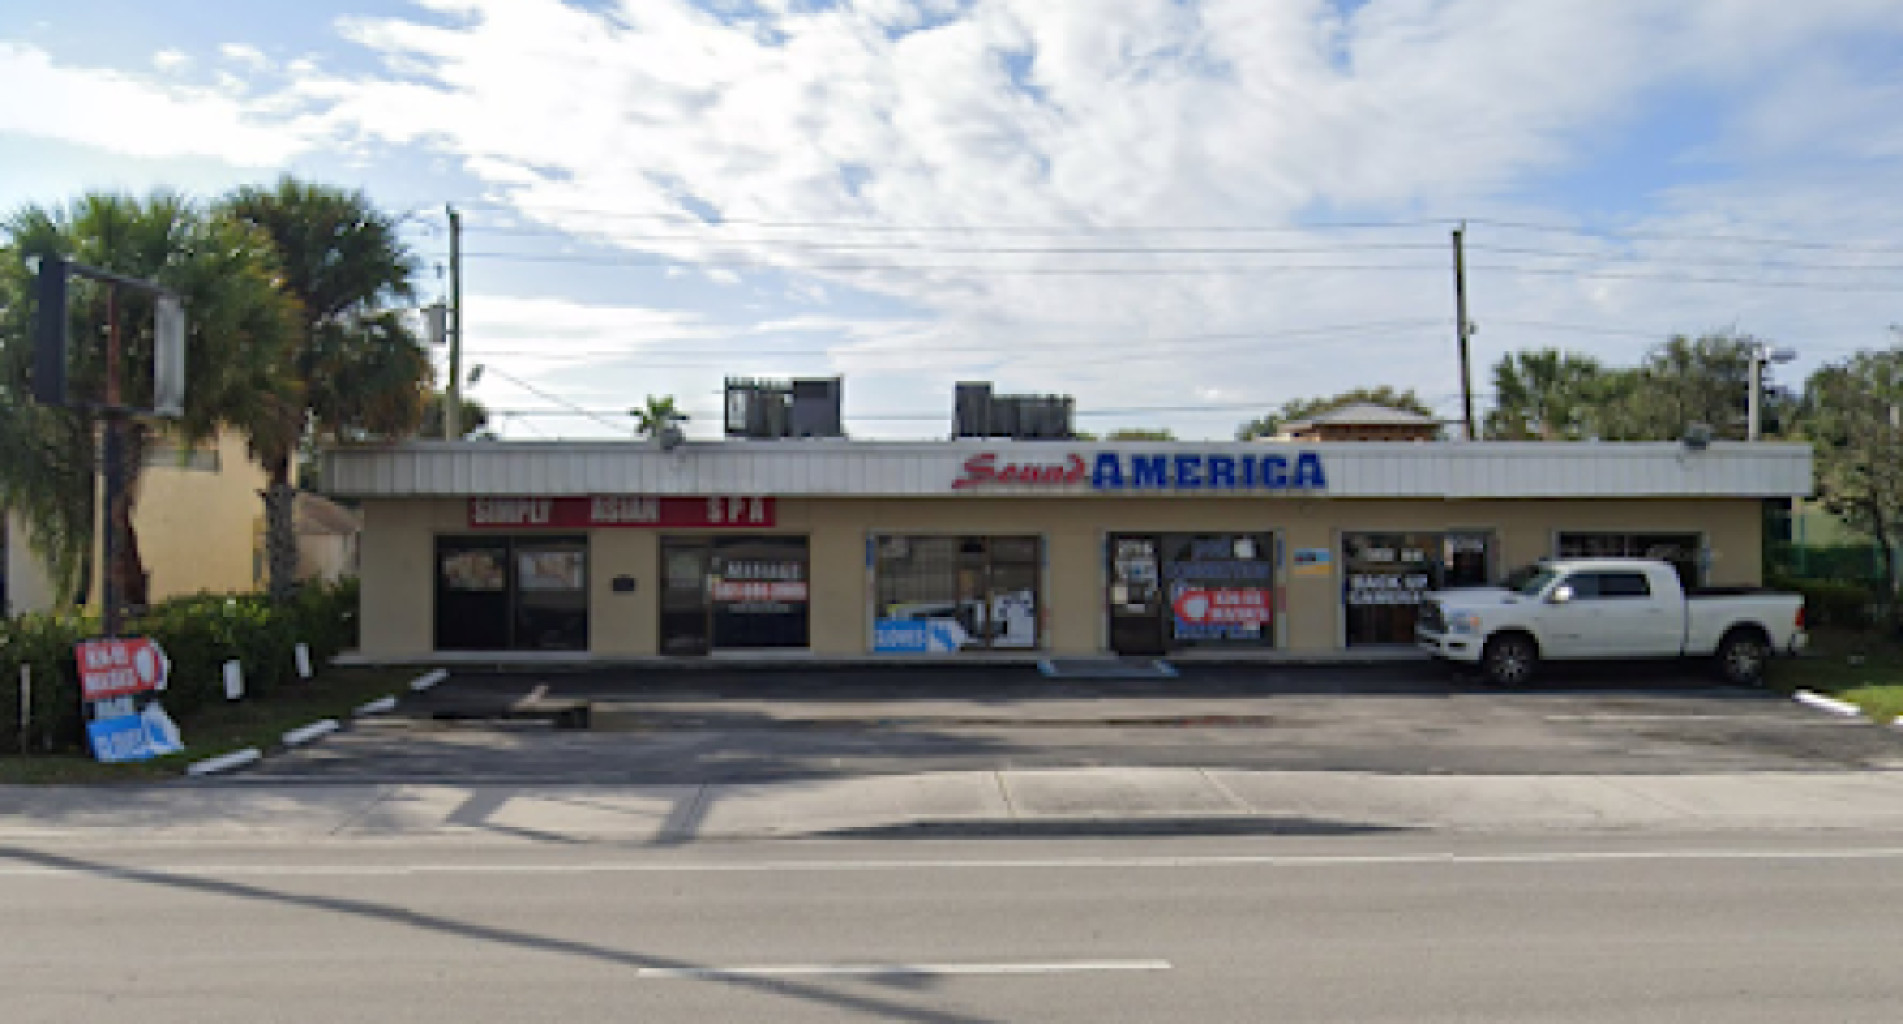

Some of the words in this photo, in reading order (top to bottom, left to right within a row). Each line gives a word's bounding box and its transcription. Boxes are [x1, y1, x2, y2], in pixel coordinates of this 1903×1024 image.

[952, 453, 1086, 490] Sound
[1092, 451, 1327, 489] AMERICA
[474, 497, 550, 524] SIMPLY
[590, 496, 660, 522] ASIAN
[1353, 574, 1400, 588] BACK
[1404, 574, 1429, 588] UP
